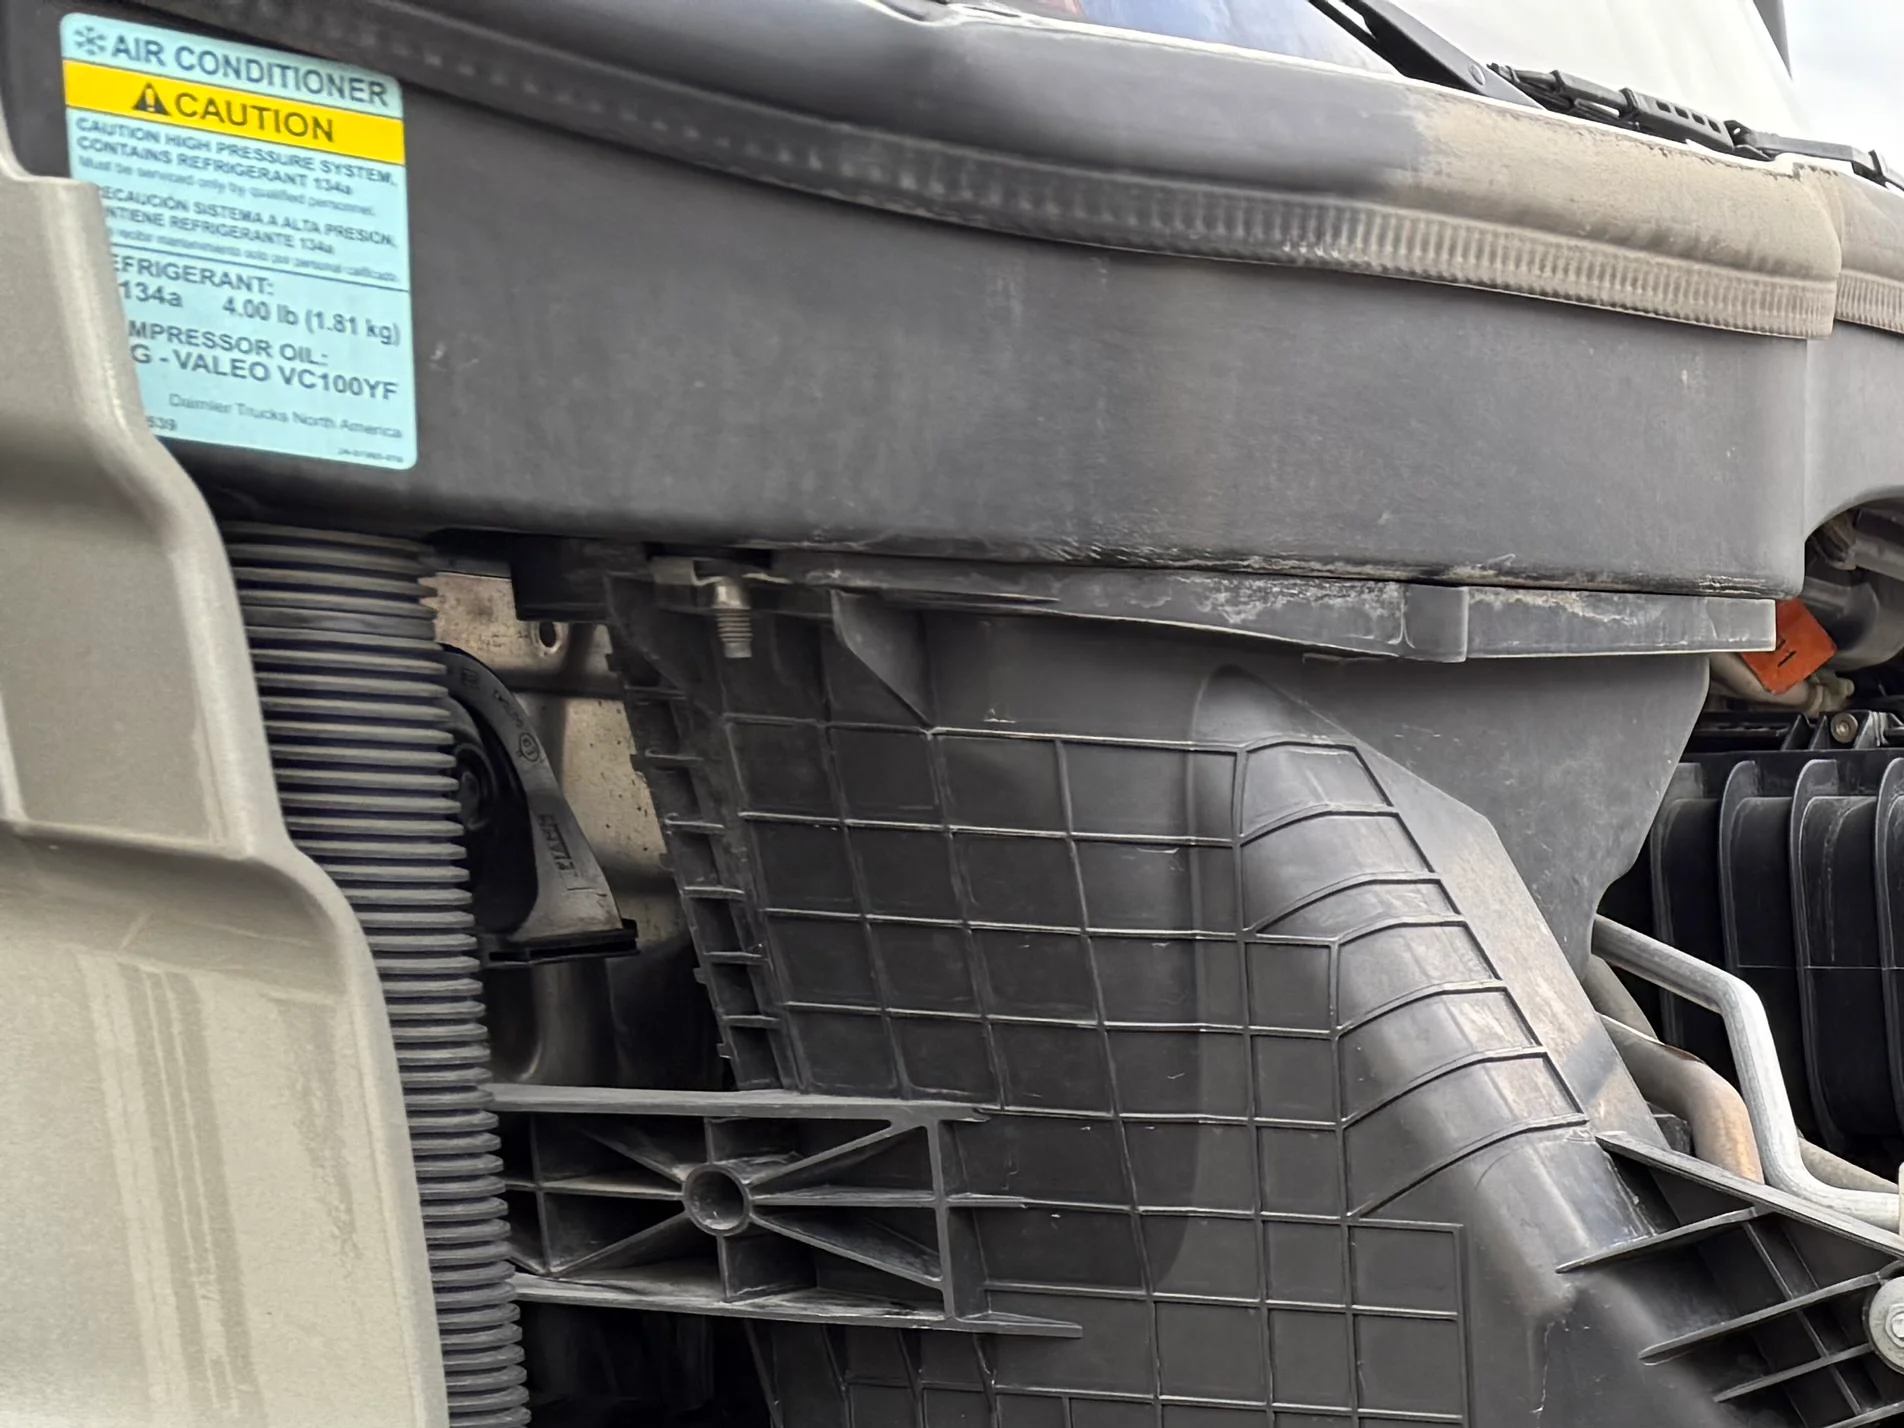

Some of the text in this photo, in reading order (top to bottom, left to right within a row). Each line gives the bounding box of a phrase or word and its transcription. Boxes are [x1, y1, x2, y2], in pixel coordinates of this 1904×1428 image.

[111, 33, 388, 107] AIR CONDITIONER
[175, 92, 334, 142] CAUTION
[75, 117, 160, 144] CAUTION
[164, 132, 210, 152] HIGH
[216, 140, 315, 171] PRESSURE
[76, 136, 354, 196] CONTAINS REFRIGERANT 134a
[108, 206, 336, 256] NTIENE REFRIGERANTE 134a
[193, 201, 263, 226] SISTEMA
[280, 215, 321, 235] ALTA
[112, 253, 275, 297] EFRIGERANT:
[118, 279, 401, 348] 134a 4.00 lb (1.81 kg)
[128, 320, 274, 360] MPRESSOR
[278, 341, 330, 367] OIL:
[174, 348, 272, 382] VALEO
[277, 364, 399, 401] VC100YF
[168, 392, 403, 440] Daimler Trucks North America
